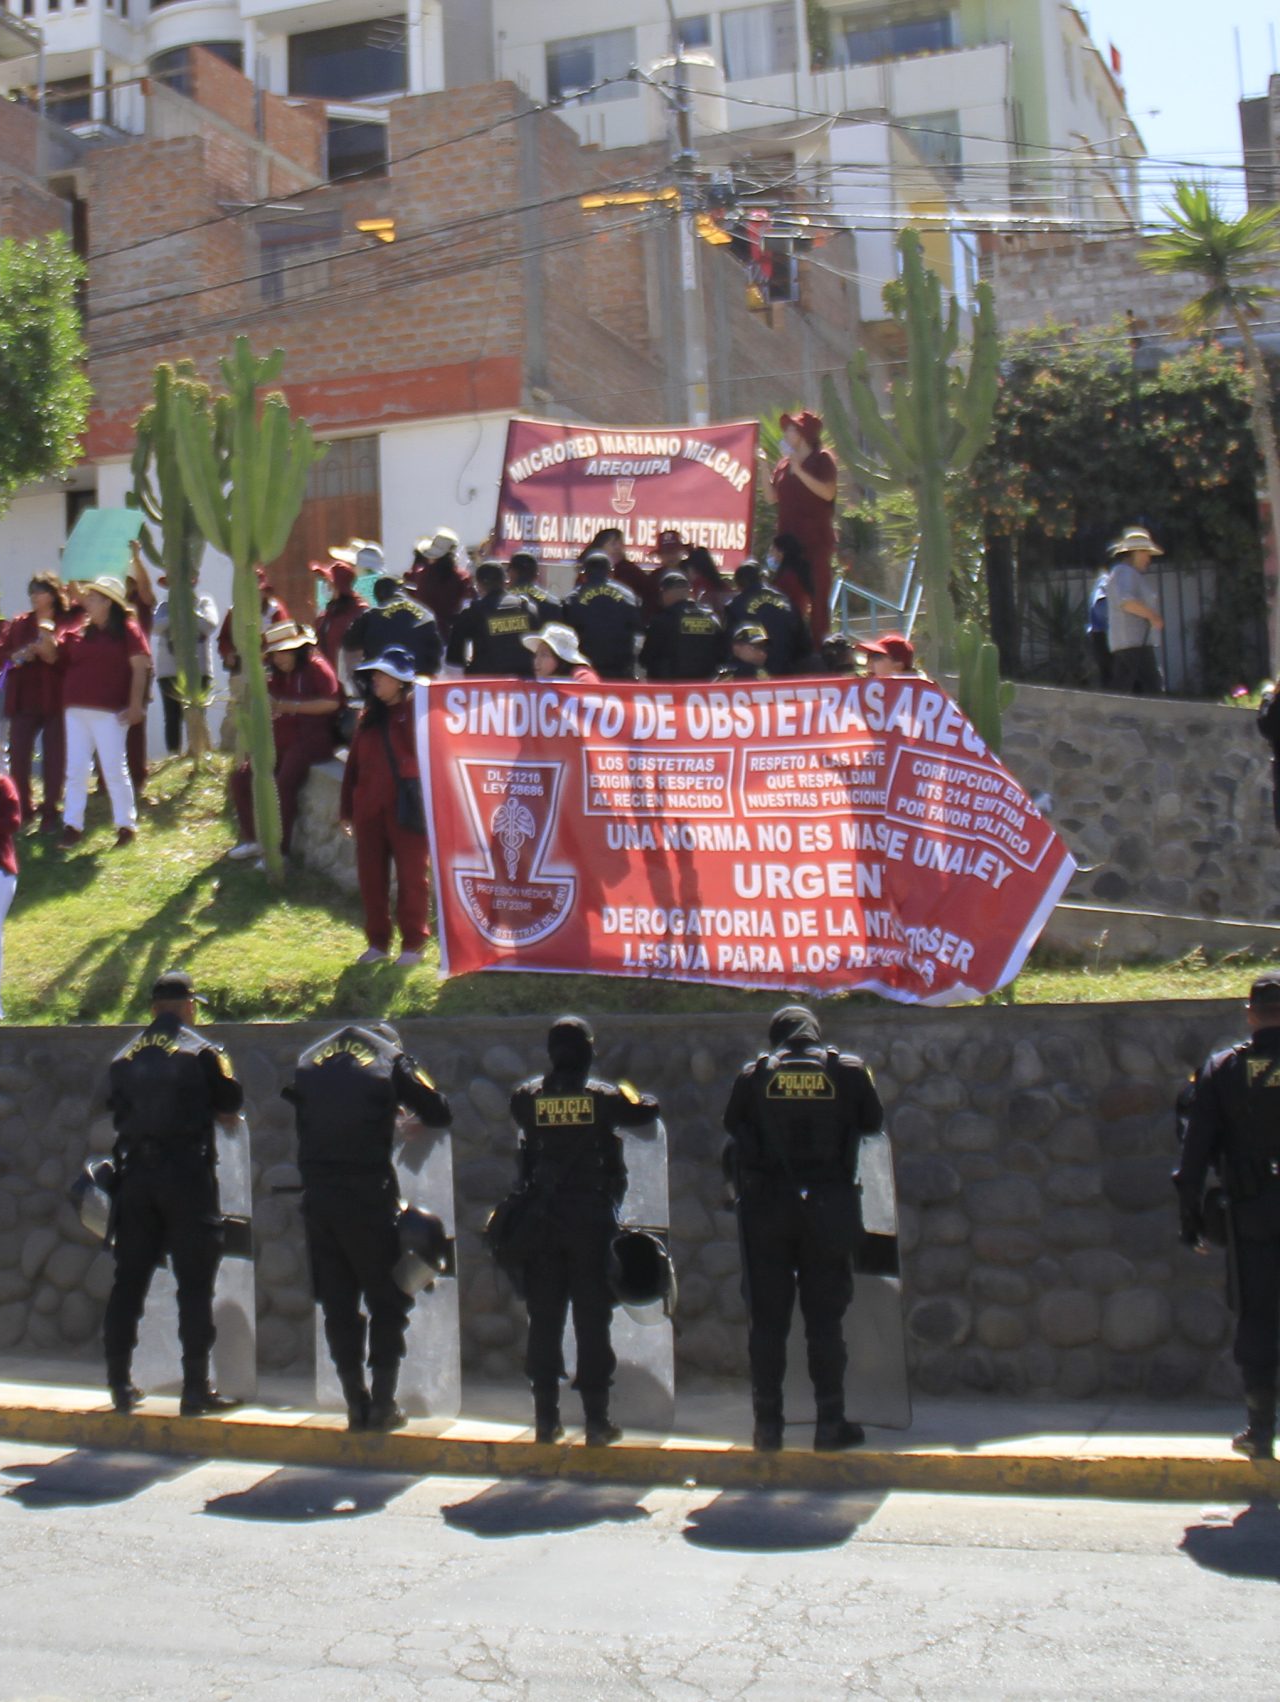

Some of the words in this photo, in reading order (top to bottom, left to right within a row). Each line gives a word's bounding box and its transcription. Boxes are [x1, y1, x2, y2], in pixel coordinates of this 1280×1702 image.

[508, 437, 599, 484] MICRORED
[600, 434, 682, 456] MARIANO
[683, 439, 752, 492] MELGAR
[585, 459, 671, 476] AREQUIPA
[503, 514, 558, 543] HUELGA
[638, 519, 658, 547] DE
[579, 587, 625, 606] POLICIA
[490, 617, 529, 634] POLICIA
[445, 687, 625, 738] SINDICATO
[633, 693, 678, 740] DE
[686, 681, 886, 741] OBSTETRAS
[598, 757, 624, 771] LOS
[627, 757, 715, 772] OBSTETRAS
[750, 755, 806, 771] RESPETO
[809, 755, 820, 769] A
[822, 753, 851, 768] LAS
[487, 770, 504, 782] DL
[506, 771, 541, 783] 21210
[590, 774, 655, 789] EXIGIMOS
[658, 775, 725, 791] RESPETO
[766, 774, 796, 789] QUE
[798, 771, 877, 789] RESPALDAN
[912, 760, 1004, 795] CORRUPCIÓN
[1003, 788, 1026, 807] EN
[482, 783, 507, 795] LEY
[916, 782, 942, 800] NTS
[944, 788, 970, 807] 214
[593, 792, 612, 807] AL
[614, 793, 664, 808] RECIEN
[668, 794, 724, 809] NACIDO
[748, 792, 819, 808] NUESTRAS
[896, 797, 926, 818] POR
[928, 804, 975, 828] FAVOR
[606, 823, 658, 851] UNA
[663, 823, 752, 852] NORMA
[756, 824, 793, 853] NO
[797, 823, 833, 854] ES
[912, 837, 965, 875] UNA
[602, 906, 777, 938] DEROGATORIA
[781, 910, 819, 938] DE
[824, 908, 860, 937] LA
[622, 942, 710, 971] LESIVA
[717, 944, 785, 973] PARA
[790, 943, 842, 974] LOS
[312, 1040, 377, 1067] POLICIA
[777, 1075, 825, 1090] POLICIA
[538, 1100, 591, 1115] POLICIA
